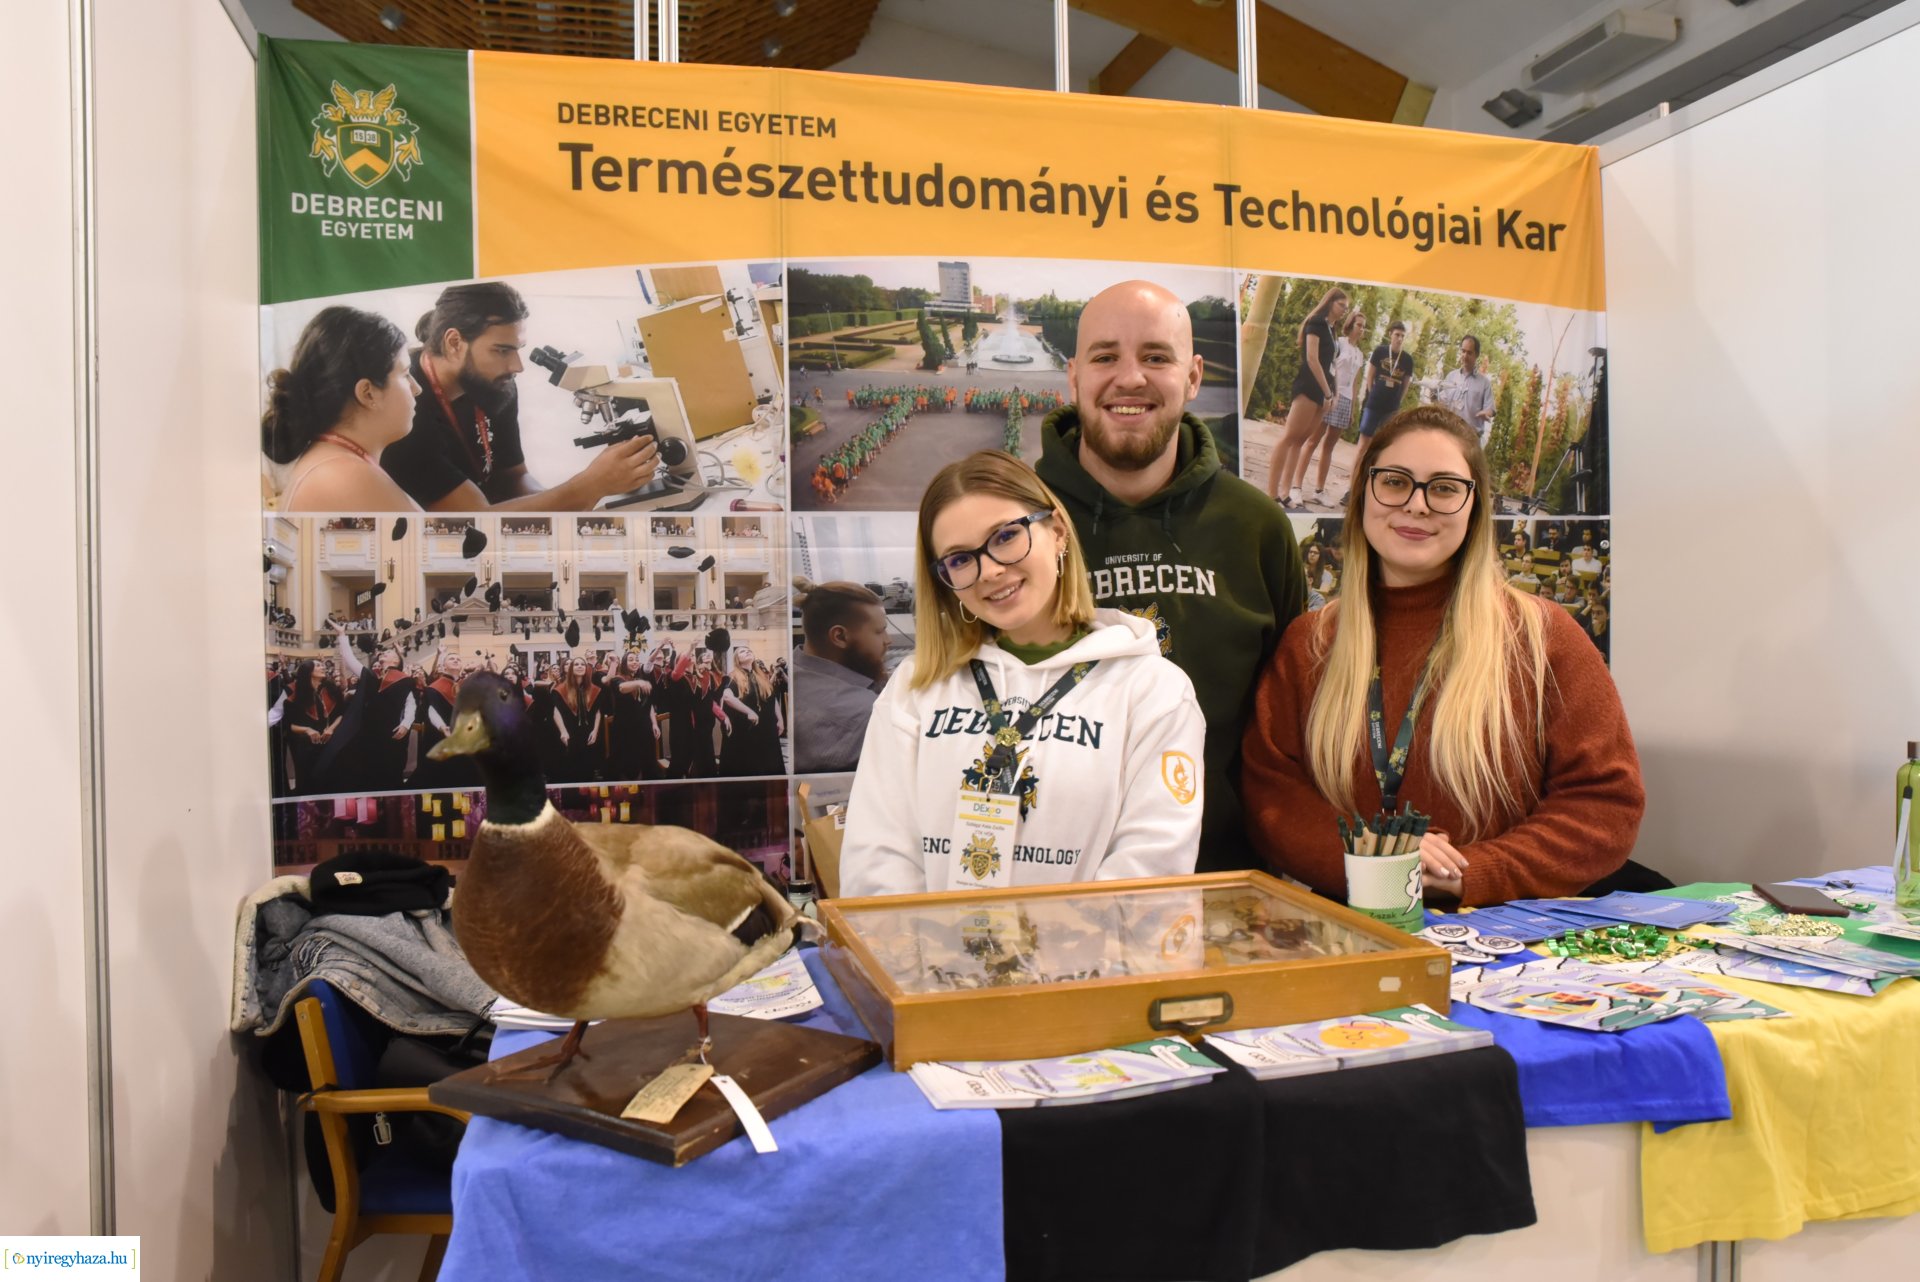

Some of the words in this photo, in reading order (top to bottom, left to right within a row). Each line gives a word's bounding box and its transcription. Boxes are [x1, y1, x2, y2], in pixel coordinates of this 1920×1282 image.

[558, 102, 708, 131] DEBRECENI
[718, 111, 836, 139] EGYETEM
[291, 192, 443, 221] DEBRECENI
[559, 142, 1128, 229] Természettudományi
[1146, 175, 1200, 224] és
[1213, 182, 1482, 253] Technológiai
[1497, 208, 1567, 253] Kar
[321, 220, 414, 240] EGYETEM
[1105, 553, 1150, 565] UNIVERSITY
[1153, 553, 1163, 562] OF
[1088, 564, 1217, 600] BRECEN
[1012, 844, 1082, 866] HNOLOGY
